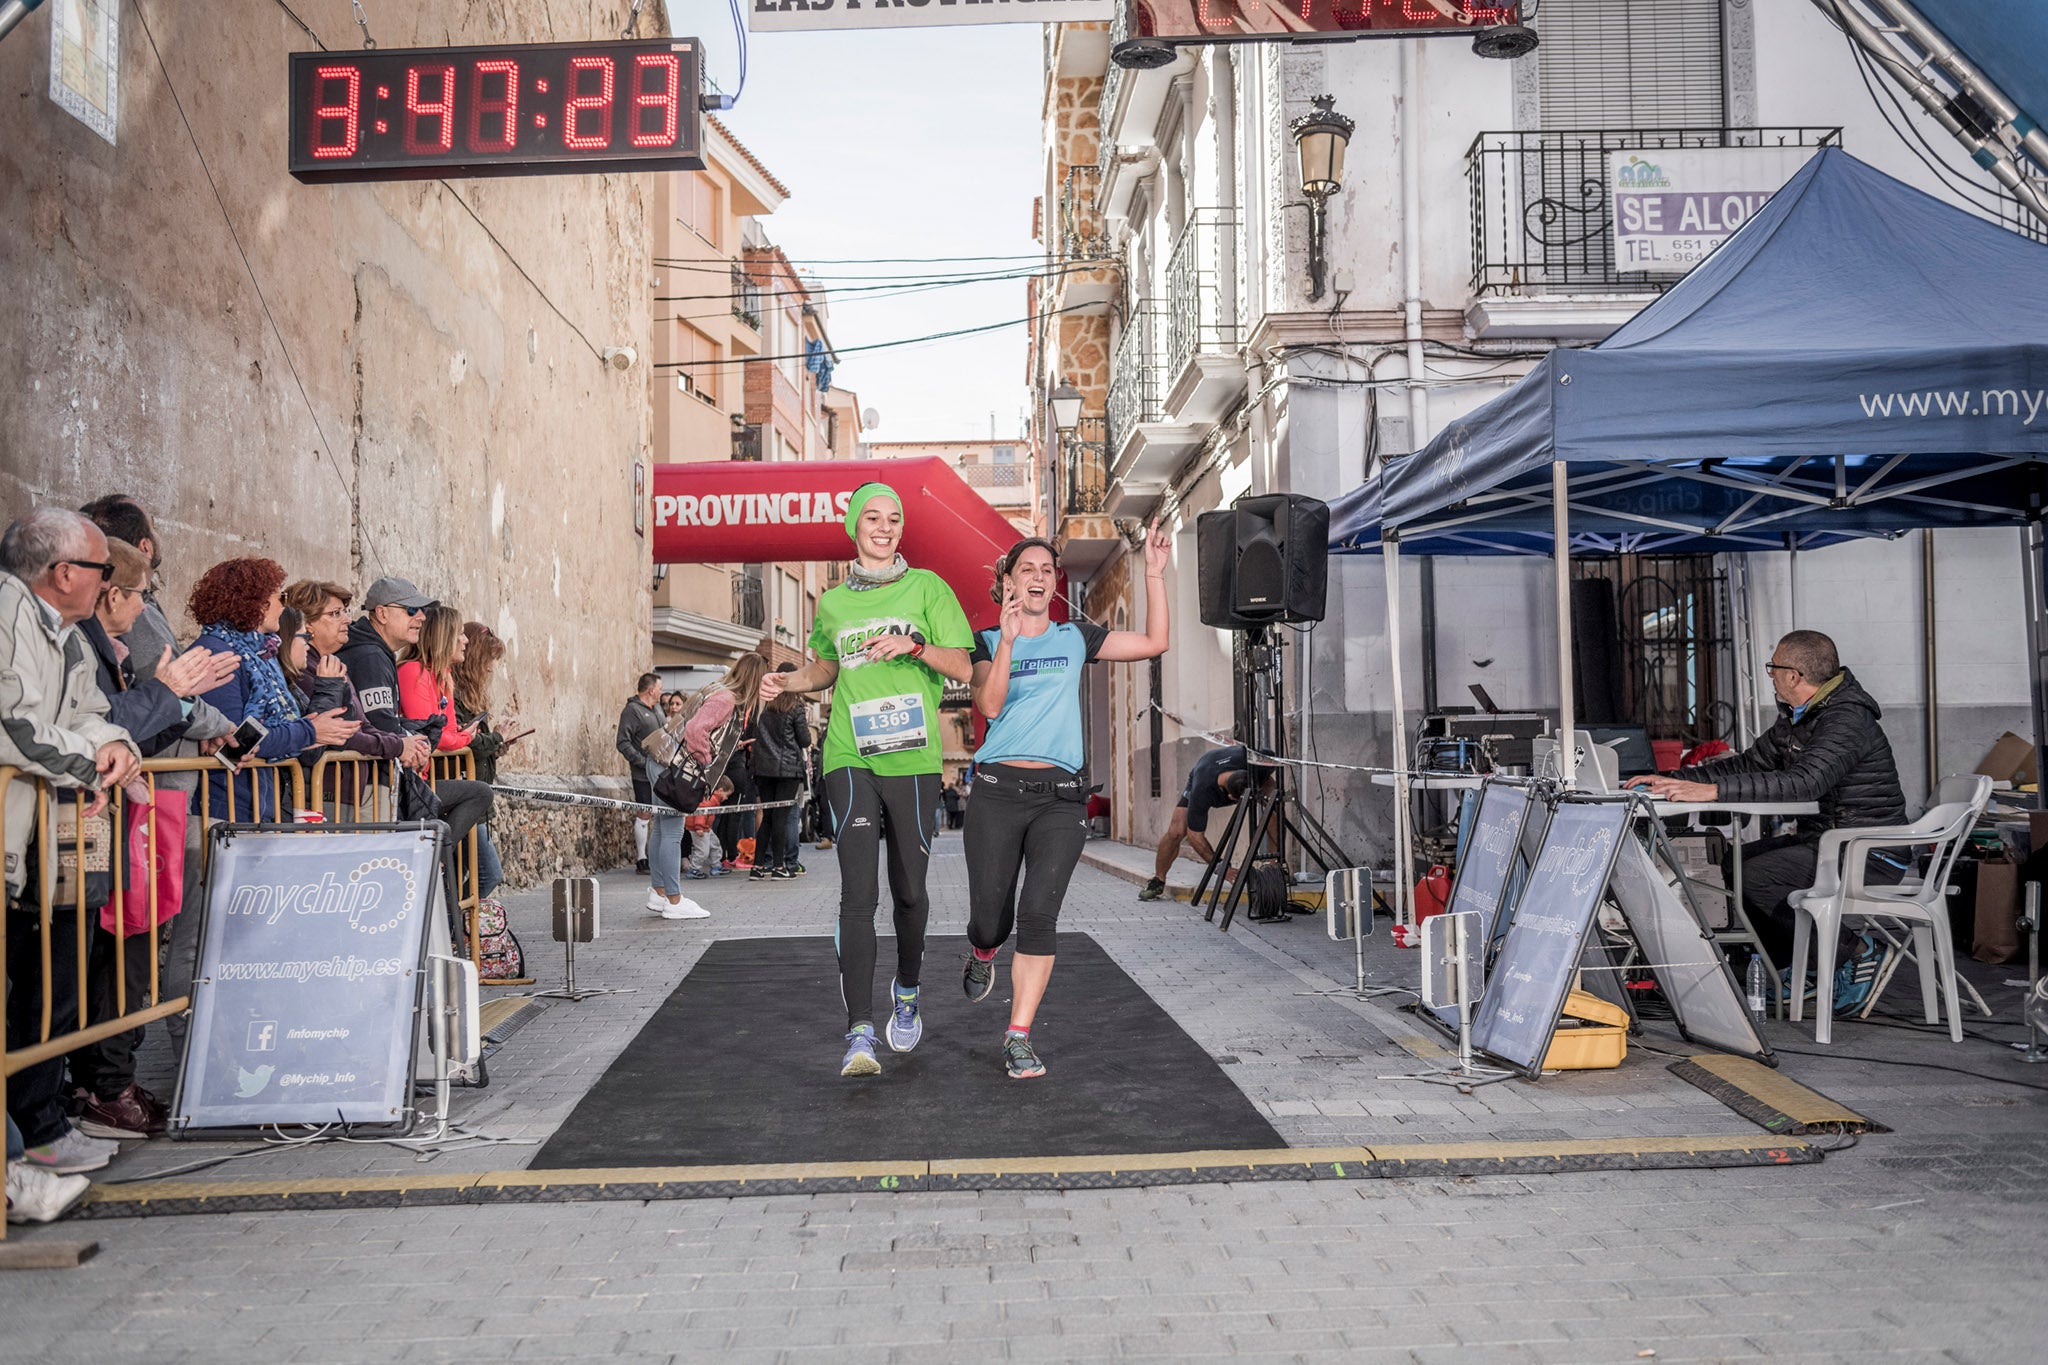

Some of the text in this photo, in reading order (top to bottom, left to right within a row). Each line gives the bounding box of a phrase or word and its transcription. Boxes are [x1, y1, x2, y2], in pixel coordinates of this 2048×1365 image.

[311, 54, 681, 158] 3:47:23
[1622, 197, 1664, 231] SE
[1672, 240, 1701, 250] 651
[1859, 389, 2048, 425] www.my
[654, 492, 853, 527] PROVINCIAS
[868, 711, 910, 730] 1369
[228, 872, 383, 925] mychip
[218, 956, 401, 983] www.mychip.es
[286, 1028, 350, 1040] /infomychip
[279, 1072, 356, 1087] @Mychip_Info
